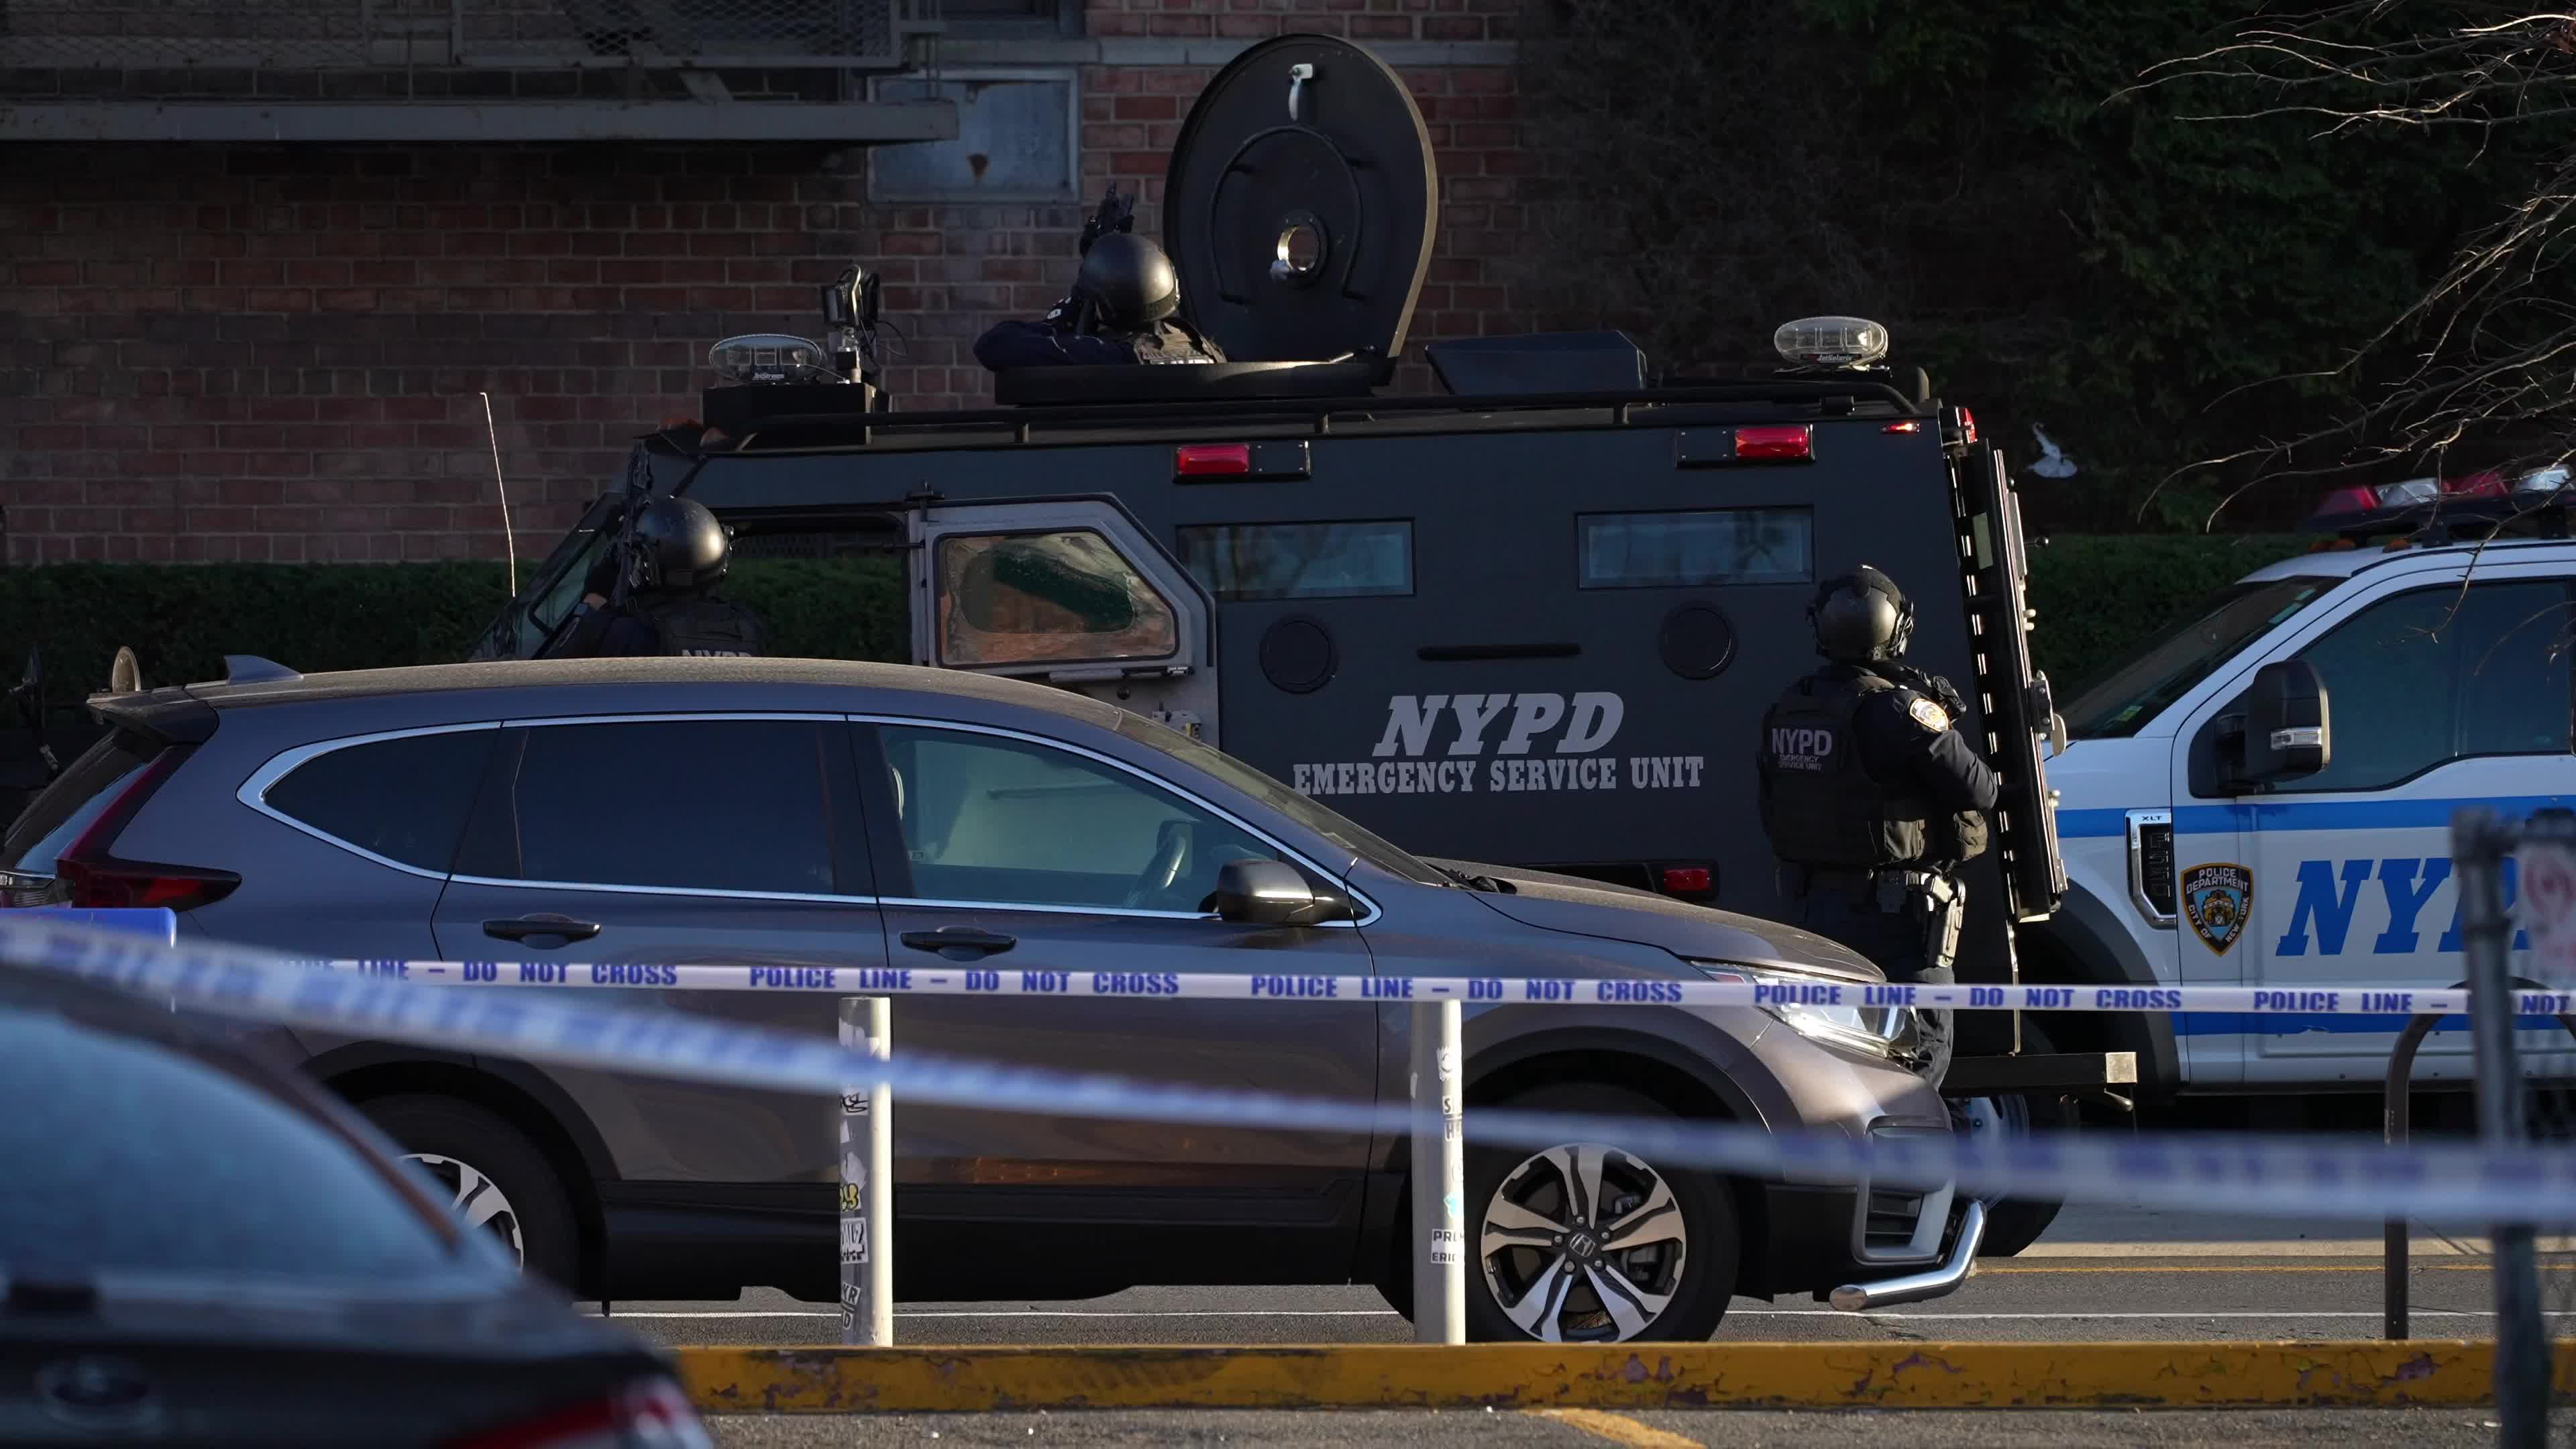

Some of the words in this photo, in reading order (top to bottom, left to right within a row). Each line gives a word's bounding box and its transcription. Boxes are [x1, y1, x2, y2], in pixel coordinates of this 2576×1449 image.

[1371, 692, 1624, 756] NYPD
[1772, 729, 1832, 756] NYPD
[1293, 761, 1476, 795] EMERGENCY
[1490, 758, 1616, 792] SERVICE
[1630, 756, 1703, 788] UNIT
[2186, 876, 2249, 894] DEPARTMENT
[2199, 868, 2237, 878] POLICE
[2276, 857, 2532, 956] NY
[2188, 904, 2201, 925] CITY
[2200, 928, 2212, 938] OF
[2225, 923, 2240, 943] NEW
[463, 962, 498, 981] DO
[519, 962, 568, 983] NOT
[590, 964, 678, 985] CROSS
[749, 967, 836, 989] POLICE
[859, 968, 912, 989] LINE
[965, 970, 999, 991] DO
[1021, 970, 1070, 992] NOT
[1091, 972, 1179, 994] CROSS
[1250, 975, 1337, 998] POLICE
[1360, 976, 1413, 998] LINE
[1467, 979, 1503, 1000] DO
[1525, 979, 1575, 1001] NOT
[1596, 979, 1682, 1002] CROSS
[1754, 984, 1841, 1005] POLICE
[1864, 986, 1917, 1006] LINE
[1969, 987, 2004, 1007] DO
[2025, 989, 2075, 1008] NOT
[2095, 989, 2182, 1009] CROSS
[2253, 991, 2339, 1012] POLICE
[2361, 993, 2413, 1013] LINE
[2522, 995, 2571, 1014] NOT
